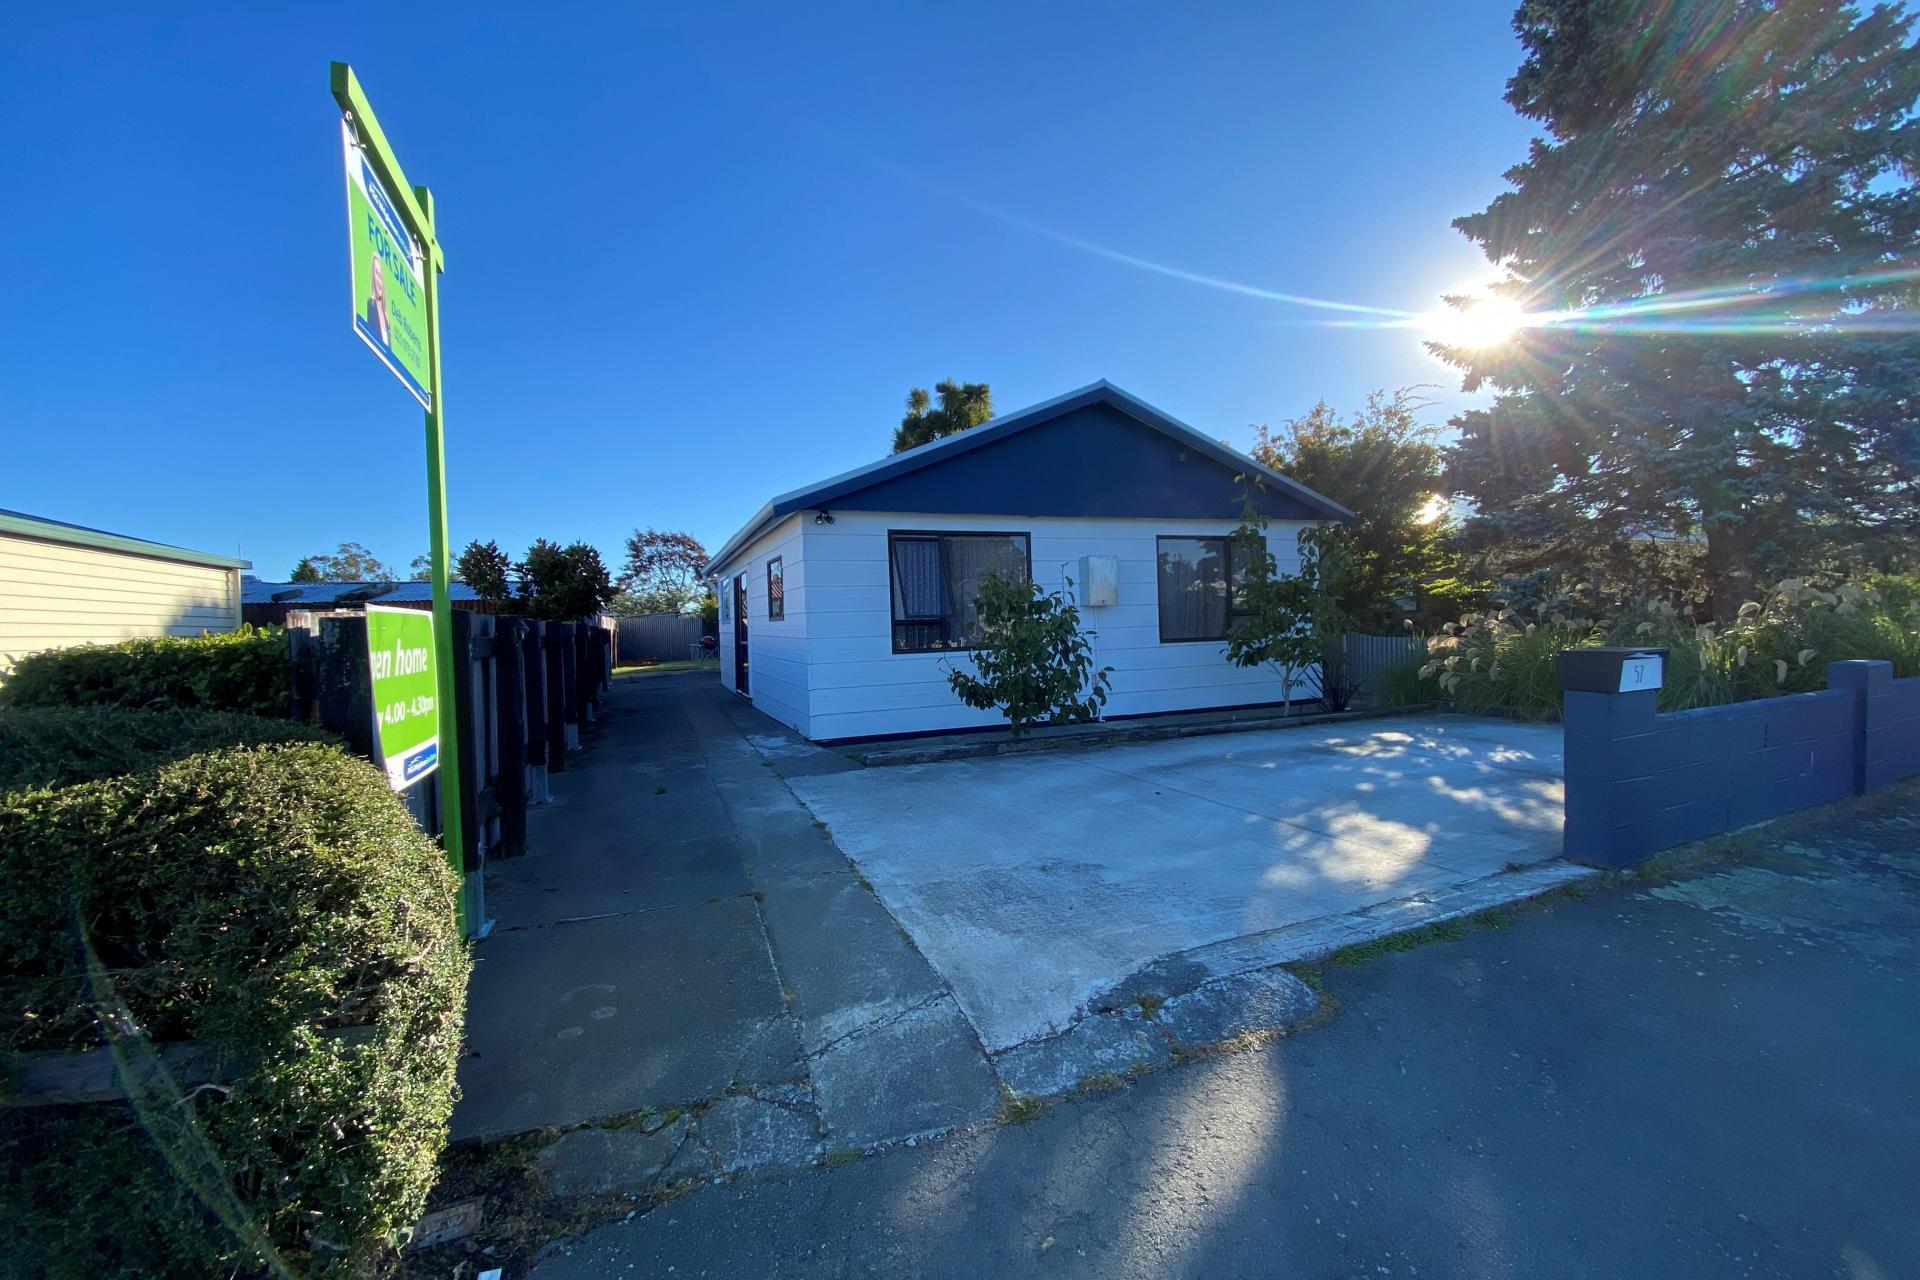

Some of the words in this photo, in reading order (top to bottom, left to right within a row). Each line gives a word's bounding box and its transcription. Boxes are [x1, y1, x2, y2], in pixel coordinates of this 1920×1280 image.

[367, 212, 392, 273] FOR
[392, 252, 417, 309] SALE
[394, 637, 429, 677] home
[1634, 664, 1645, 684] 57
[384, 700, 406, 725] 4.00
